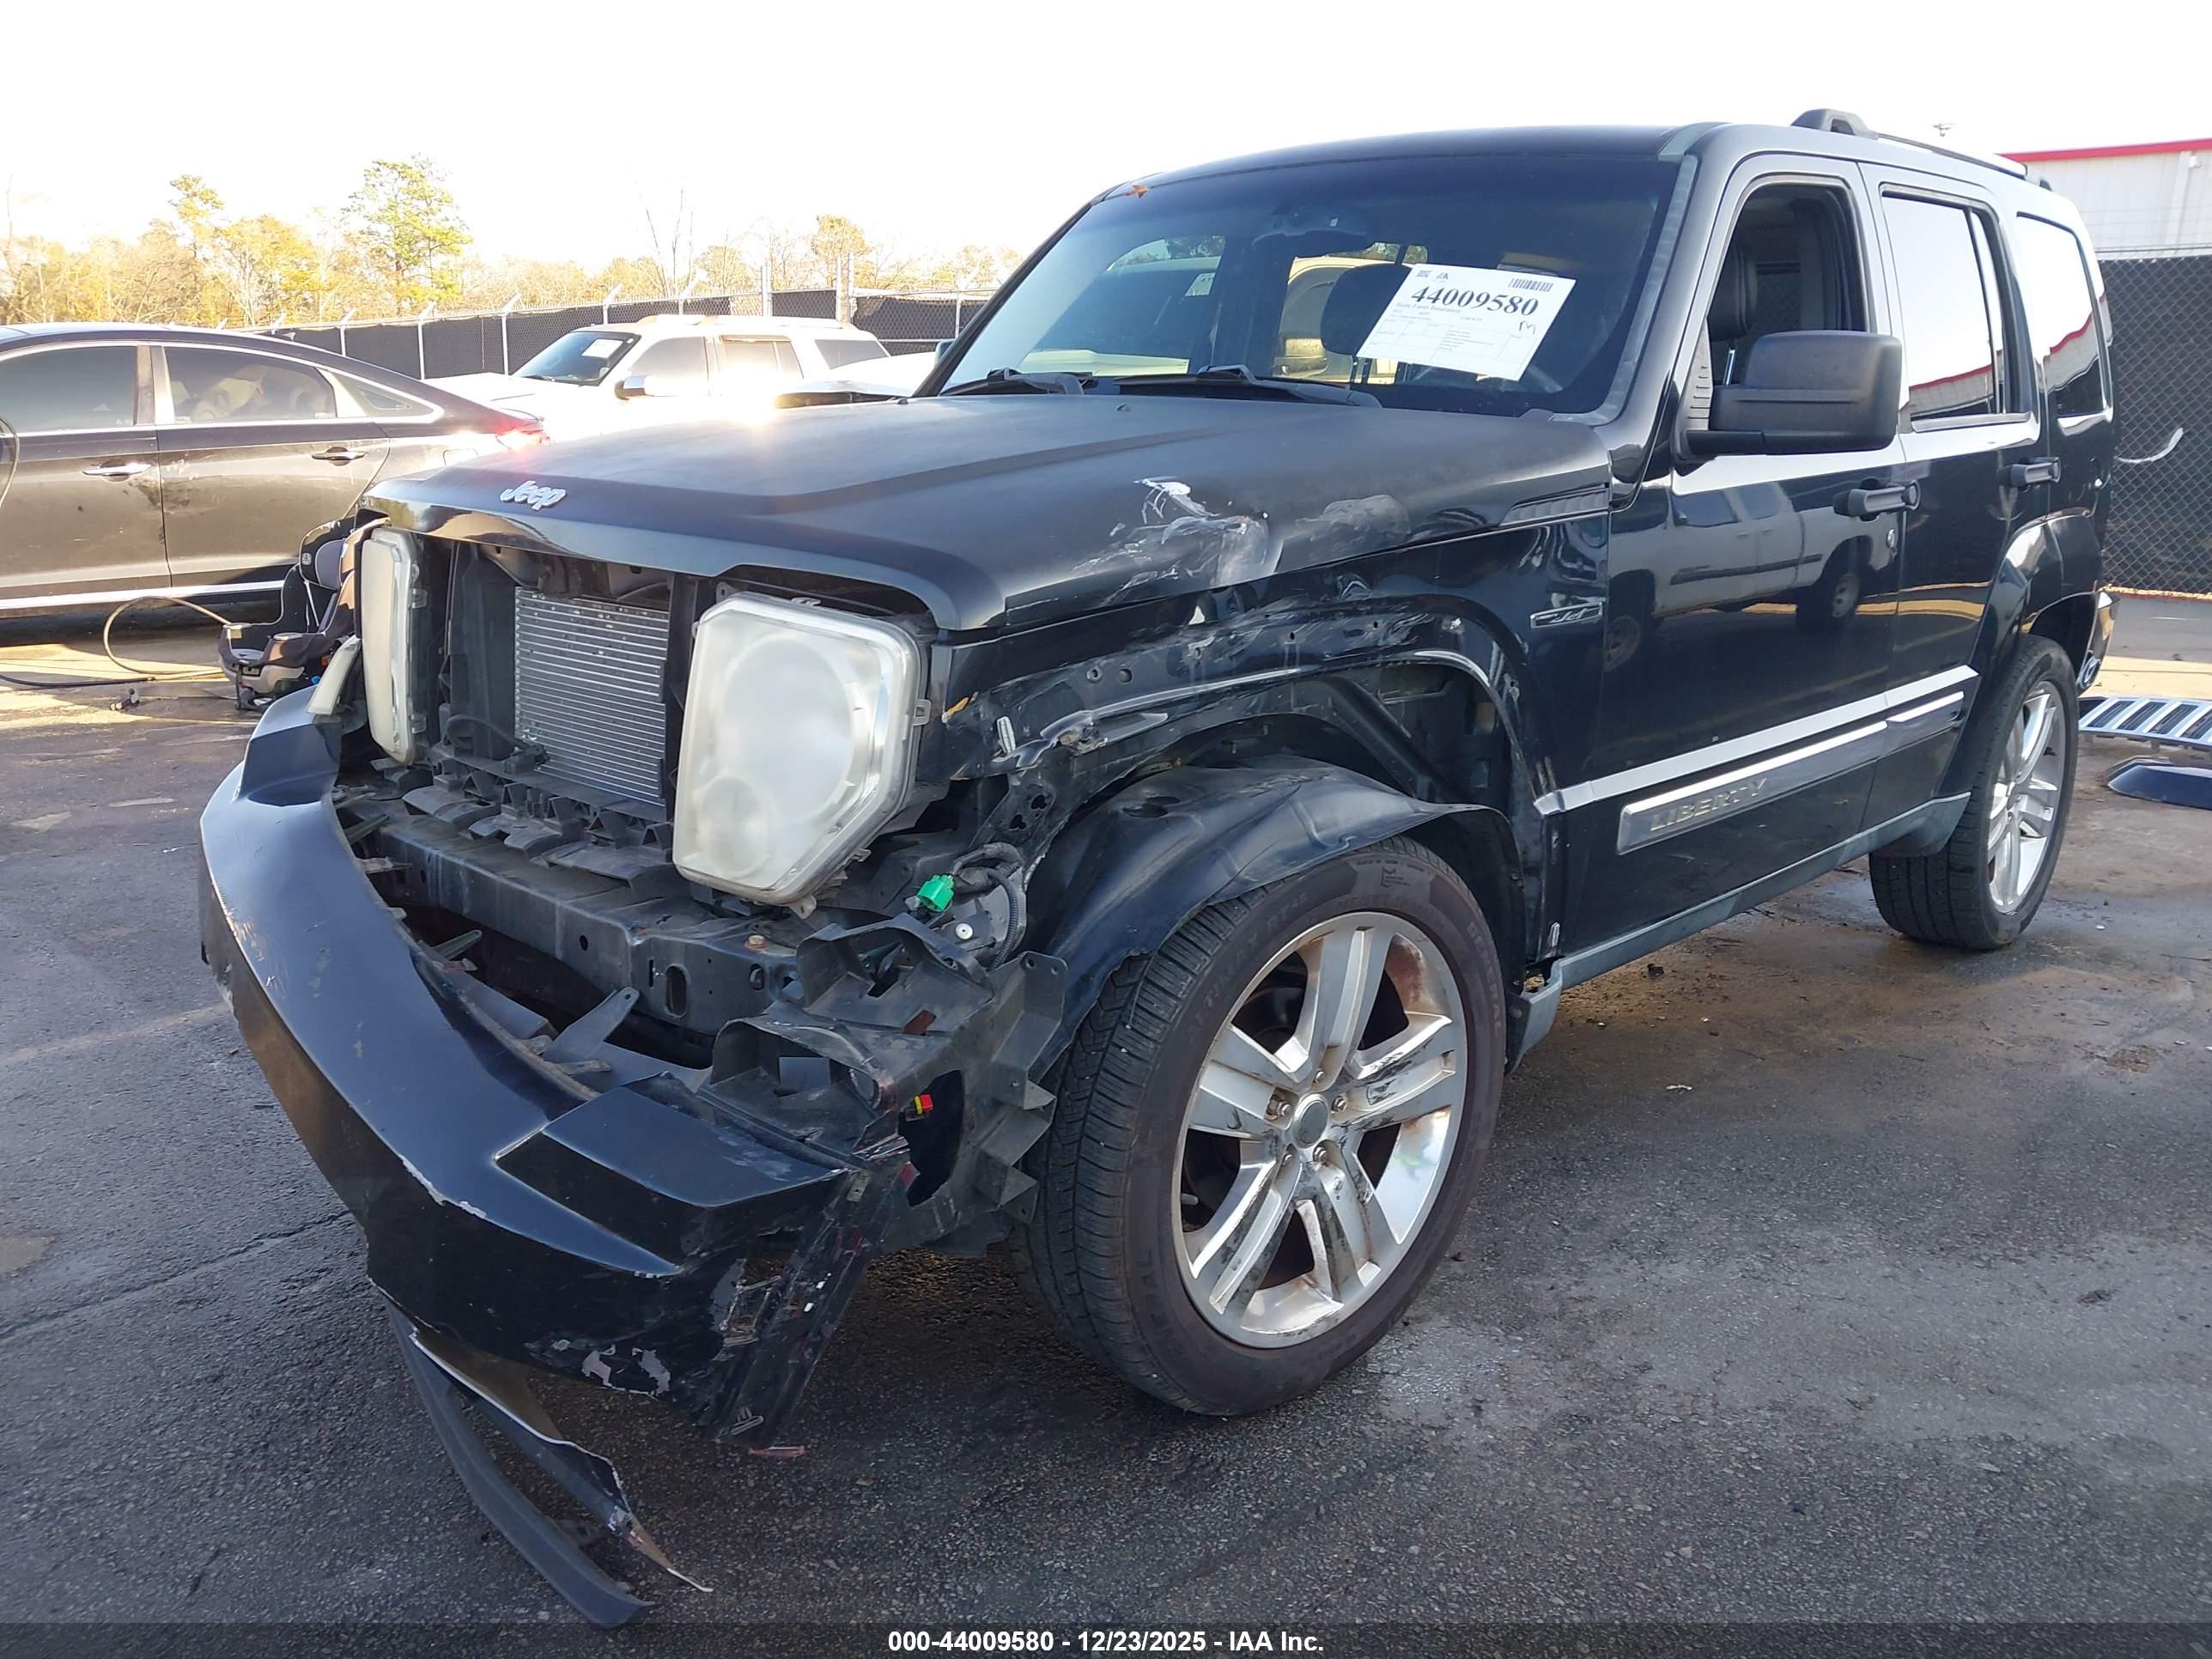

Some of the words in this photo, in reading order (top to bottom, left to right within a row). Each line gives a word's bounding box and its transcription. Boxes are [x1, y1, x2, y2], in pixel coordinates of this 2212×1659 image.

[1411, 286, 1540, 317] 44009580
[500, 480, 567, 511] Jeep
[1649, 777, 1767, 832] LIBERTY
